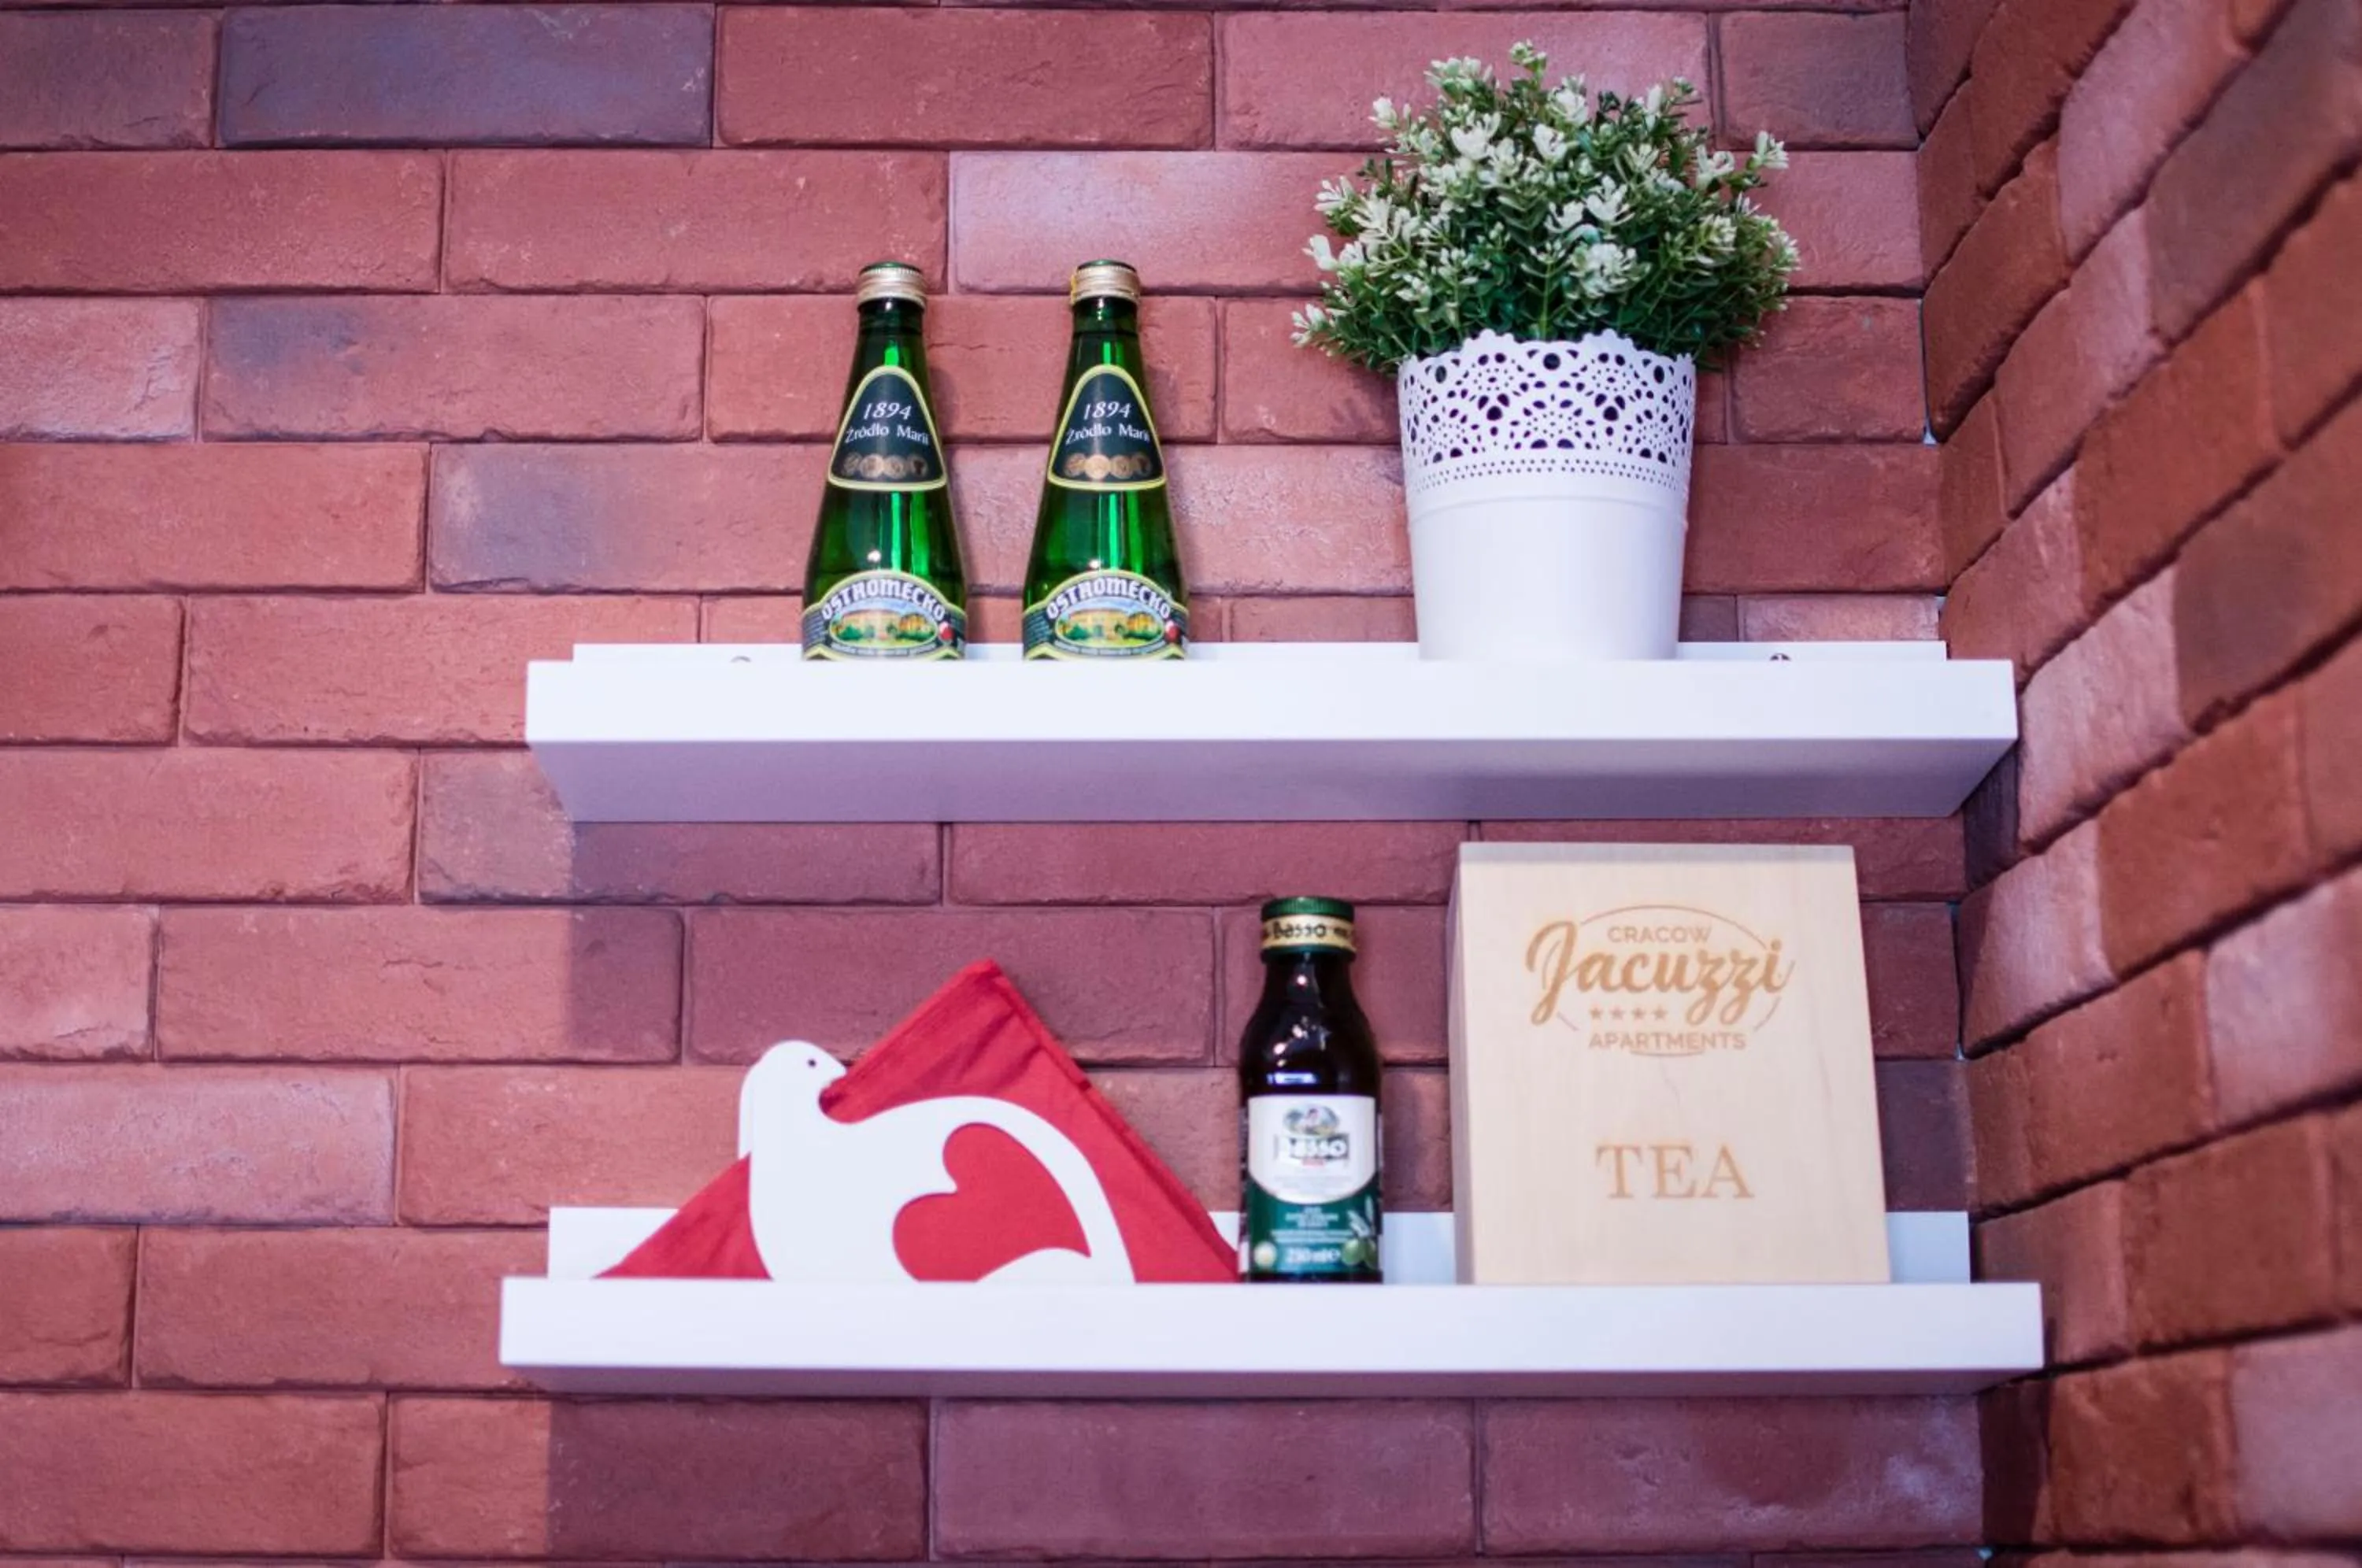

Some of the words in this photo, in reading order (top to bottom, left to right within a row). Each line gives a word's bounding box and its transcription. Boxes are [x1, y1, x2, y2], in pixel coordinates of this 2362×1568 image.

[863, 401, 912, 420] 1894
[1083, 401, 1131, 420] 1894
[821, 579, 946, 621] OSTROMECKO
[1046, 577, 1171, 619] OSTROMECKO
[1607, 926, 1712, 943] CRACOW
[1525, 920, 1796, 1026] Jacuzzi
[1588, 1031, 1746, 1050] APARTMENTS
[1595, 1144, 1755, 1200] TEA
